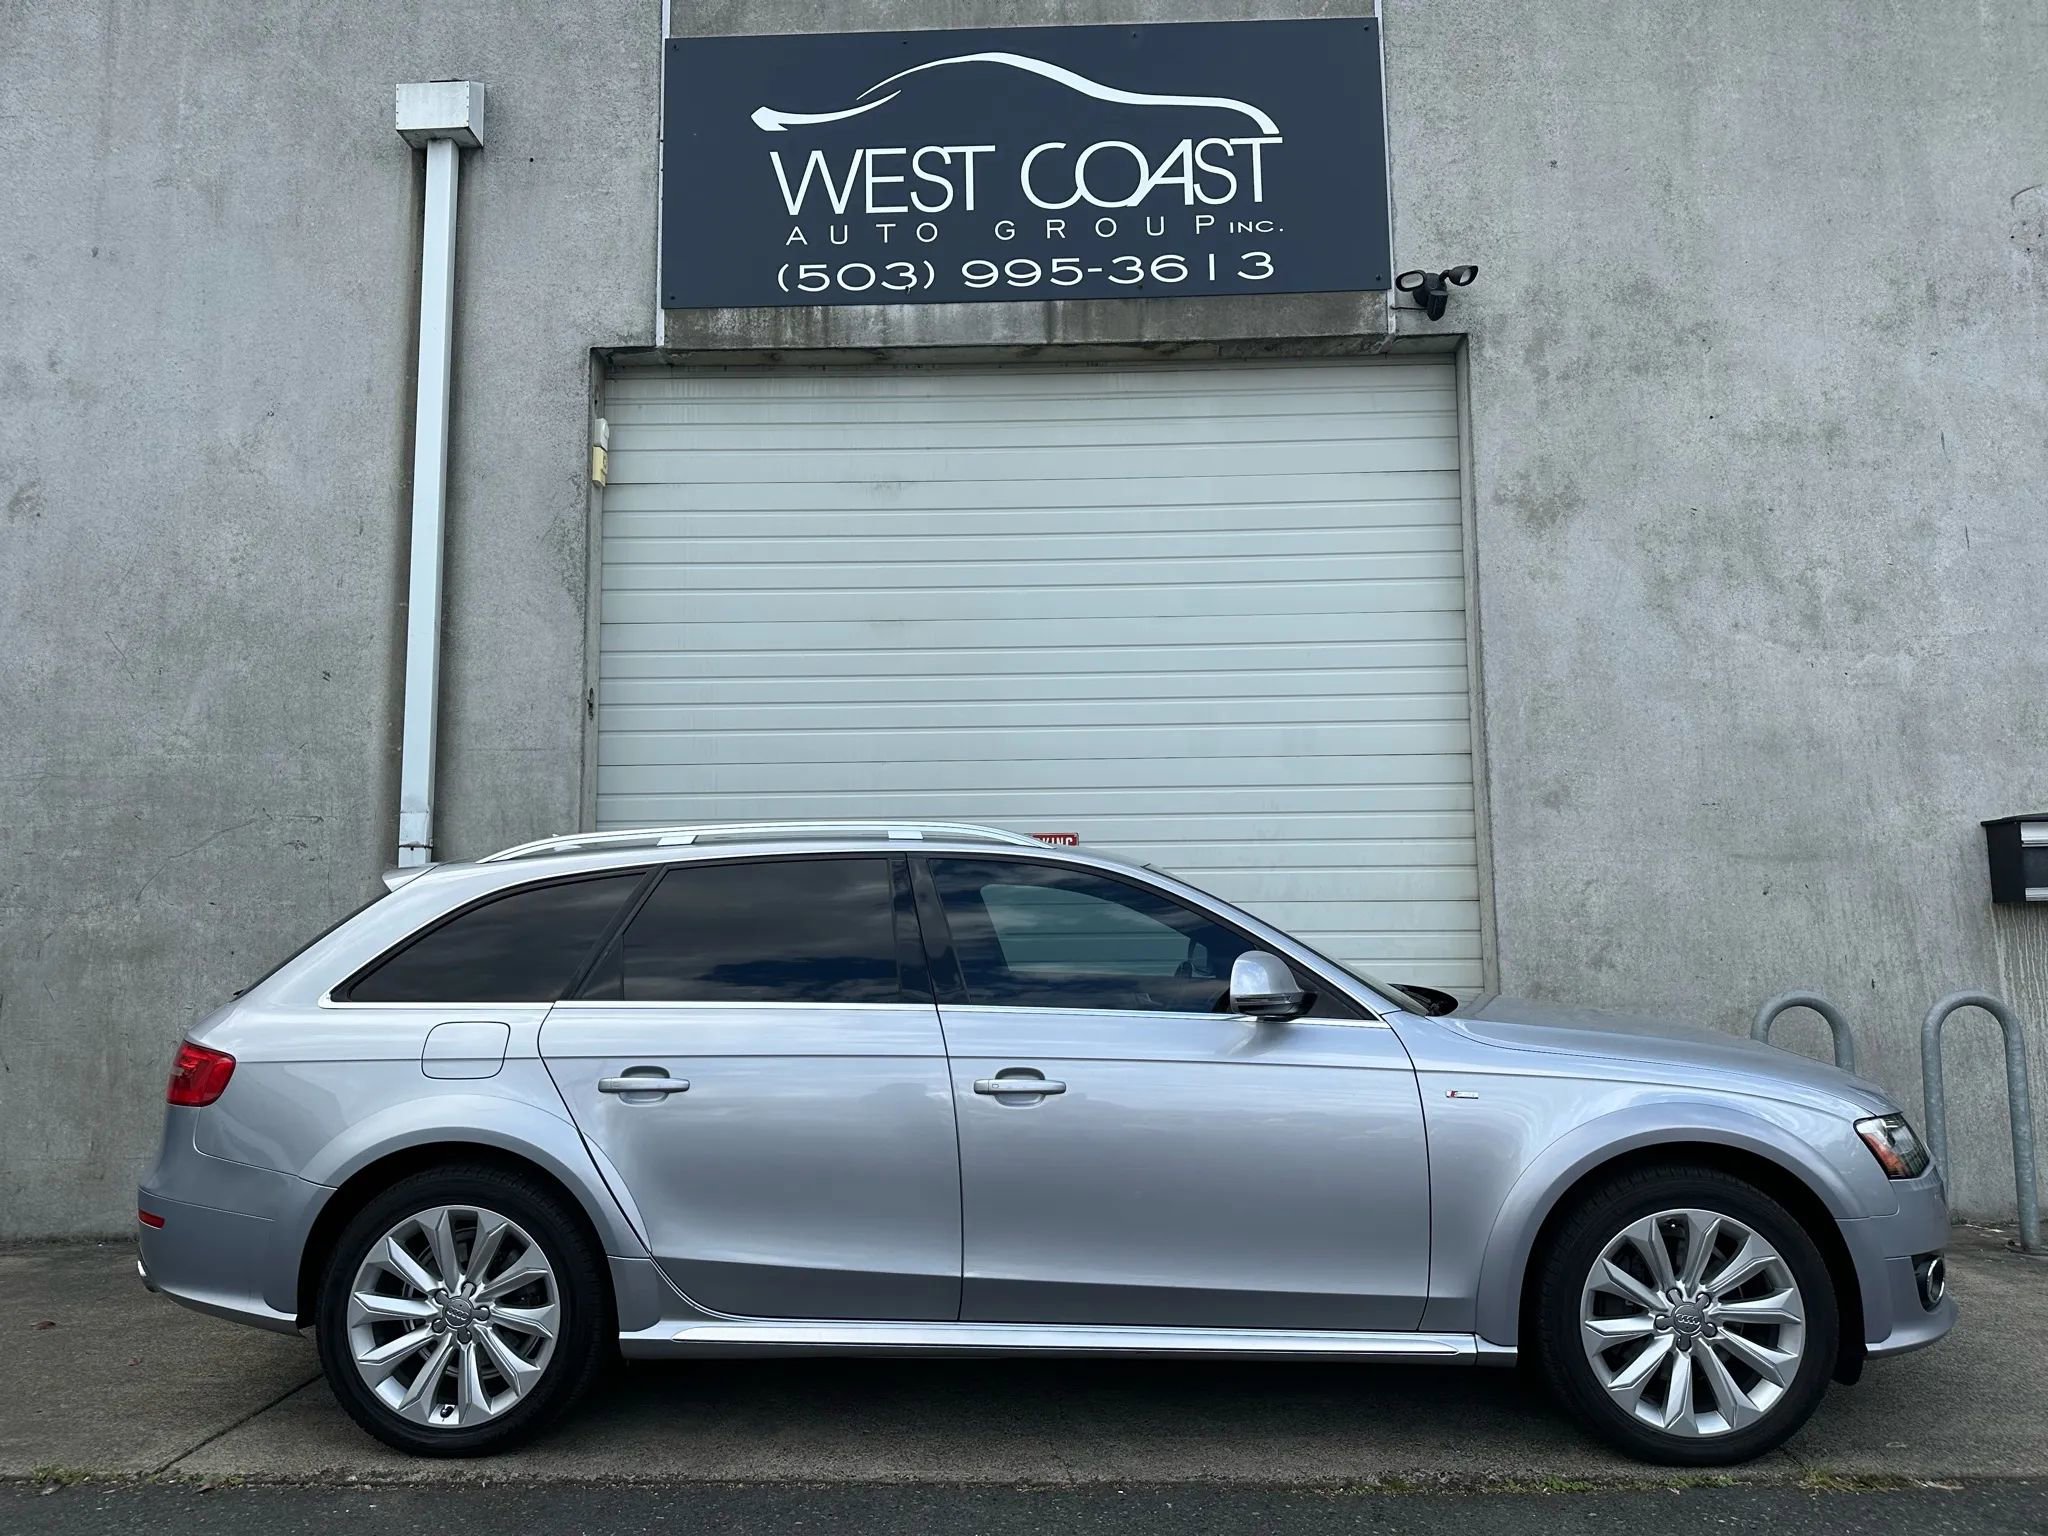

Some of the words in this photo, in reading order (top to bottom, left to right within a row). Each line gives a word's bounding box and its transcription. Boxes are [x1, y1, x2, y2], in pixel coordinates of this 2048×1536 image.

[770, 145, 996, 216] WEST
[1020, 137, 1283, 210] COAST
[785, 222, 939, 246] AUTO
[994, 214, 1216, 241] GROUP
[1229, 220, 1285, 234] INC.
[777, 259, 935, 293] (503)
[961, 251, 1275, 289] 995-3613
